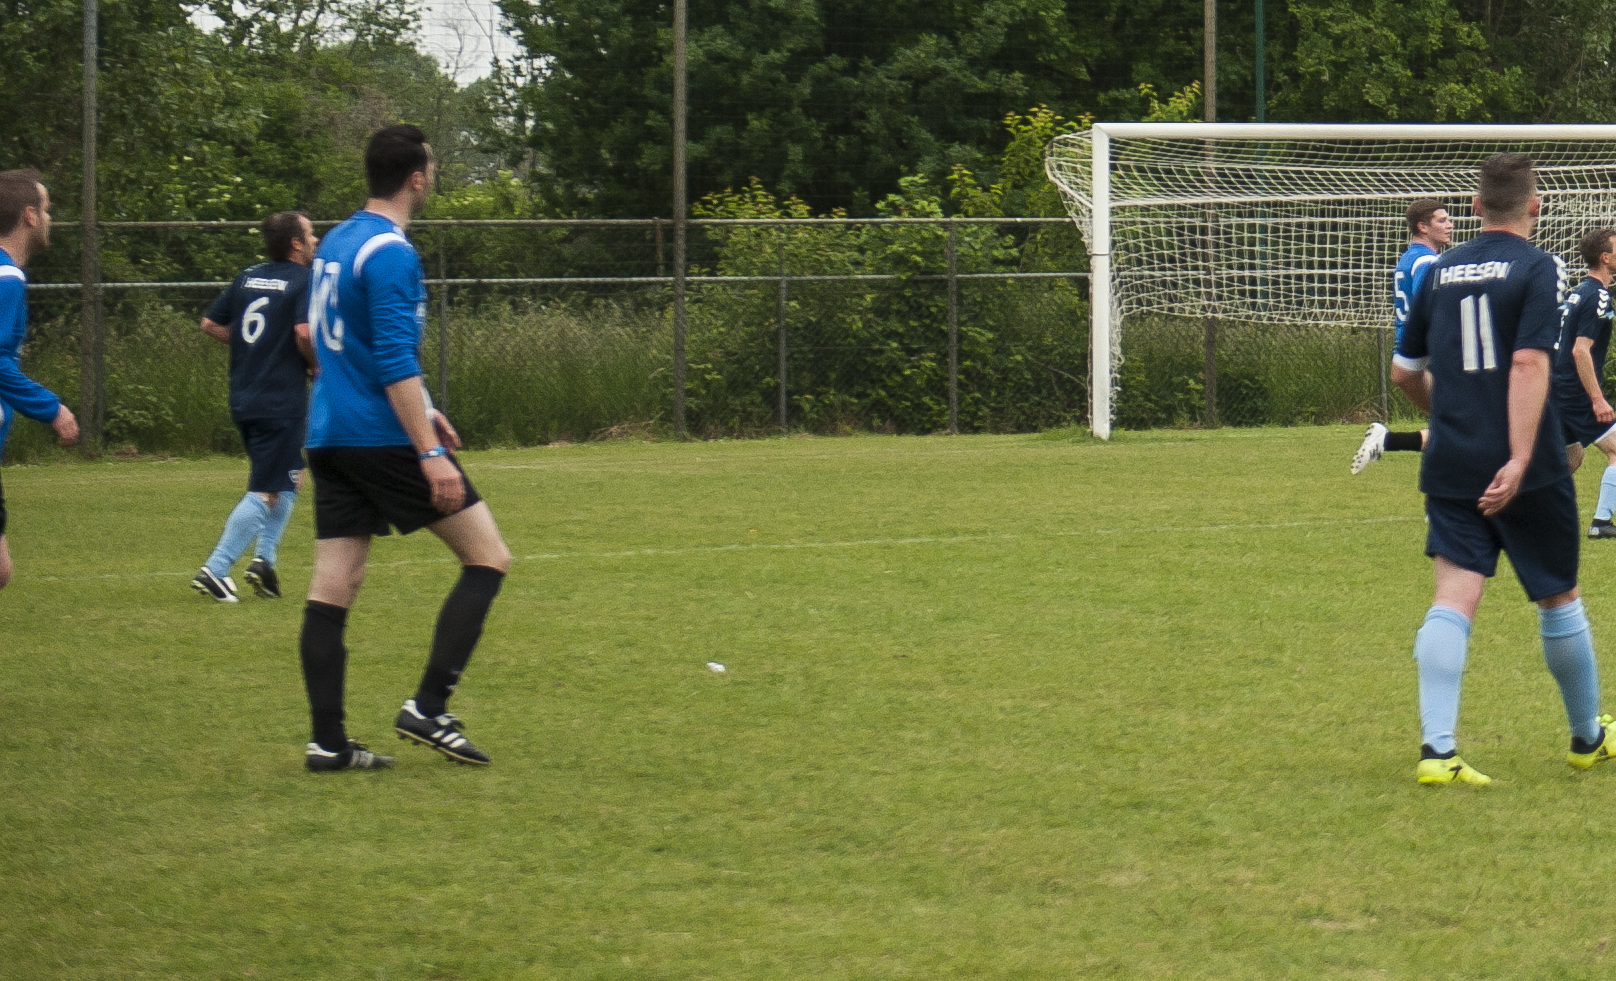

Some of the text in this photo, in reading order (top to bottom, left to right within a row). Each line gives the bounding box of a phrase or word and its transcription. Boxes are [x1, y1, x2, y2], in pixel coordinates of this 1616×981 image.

[1439, 261, 1510, 285] HEESEN
[242, 296, 270, 344] 6
[1460, 292, 1499, 372] 11
